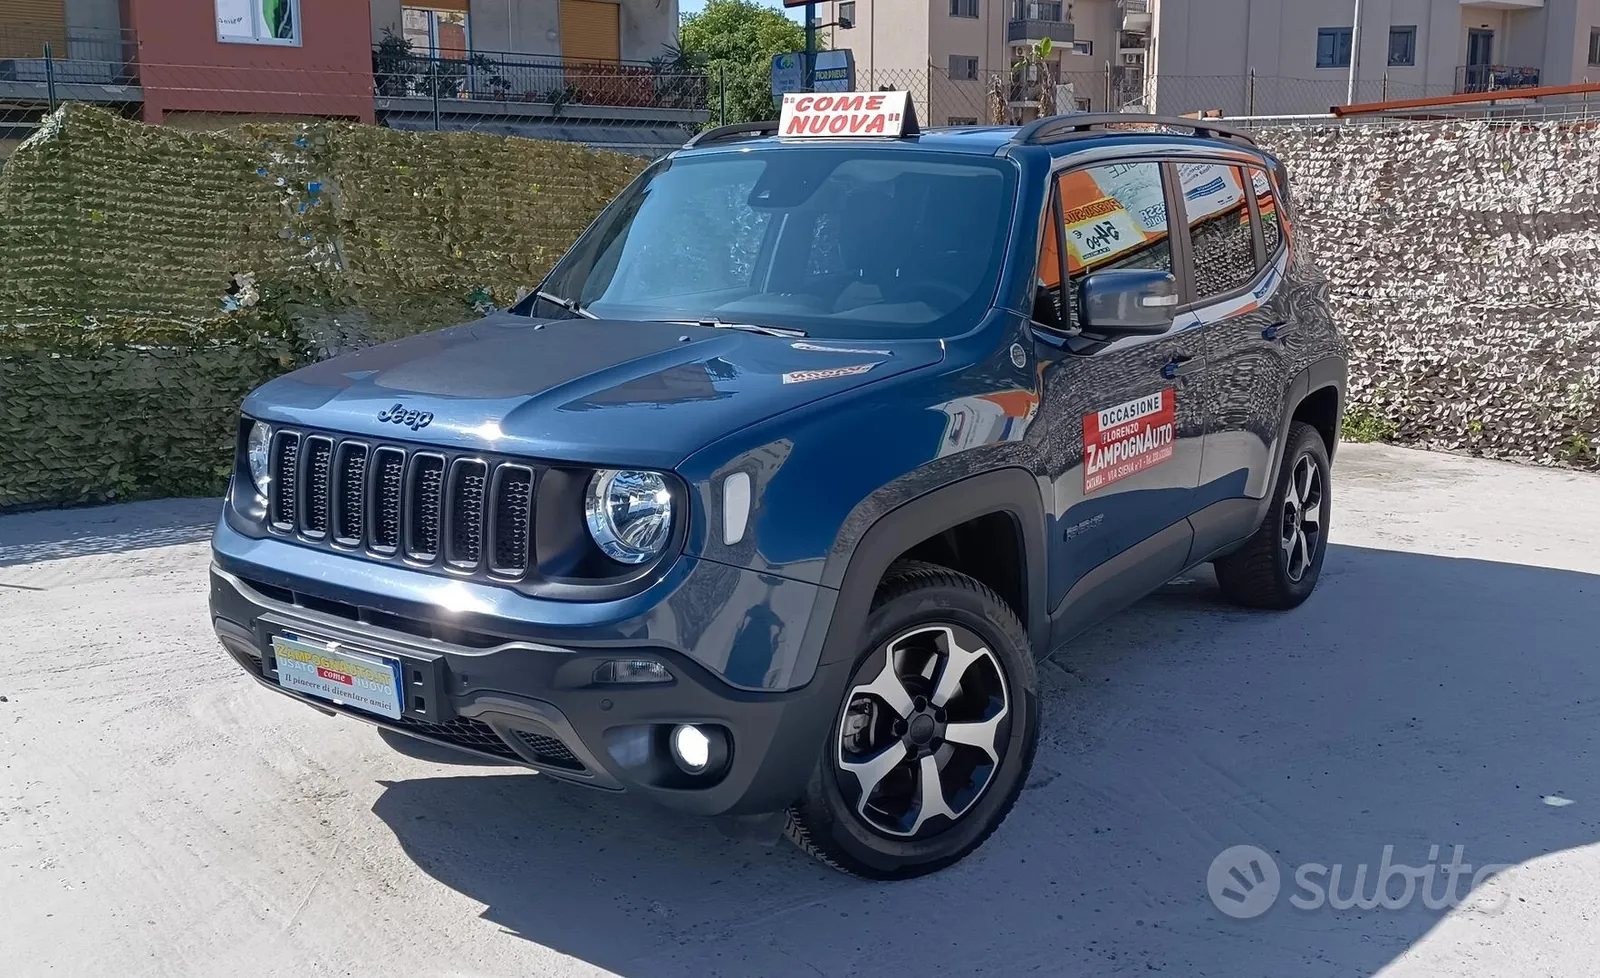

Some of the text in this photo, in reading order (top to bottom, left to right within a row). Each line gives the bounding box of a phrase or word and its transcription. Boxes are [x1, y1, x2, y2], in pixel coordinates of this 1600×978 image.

[377, 402, 434, 431] Jeep
[1102, 396, 1160, 427] OCCASIONE
[1107, 422, 1139, 442] LORENZO
[1117, 462, 1135, 478] SIENA
[281, 657, 315, 674] USATO
[323, 670, 346, 682] come
[285, 674, 392, 711] Il piacere di diventare amici
